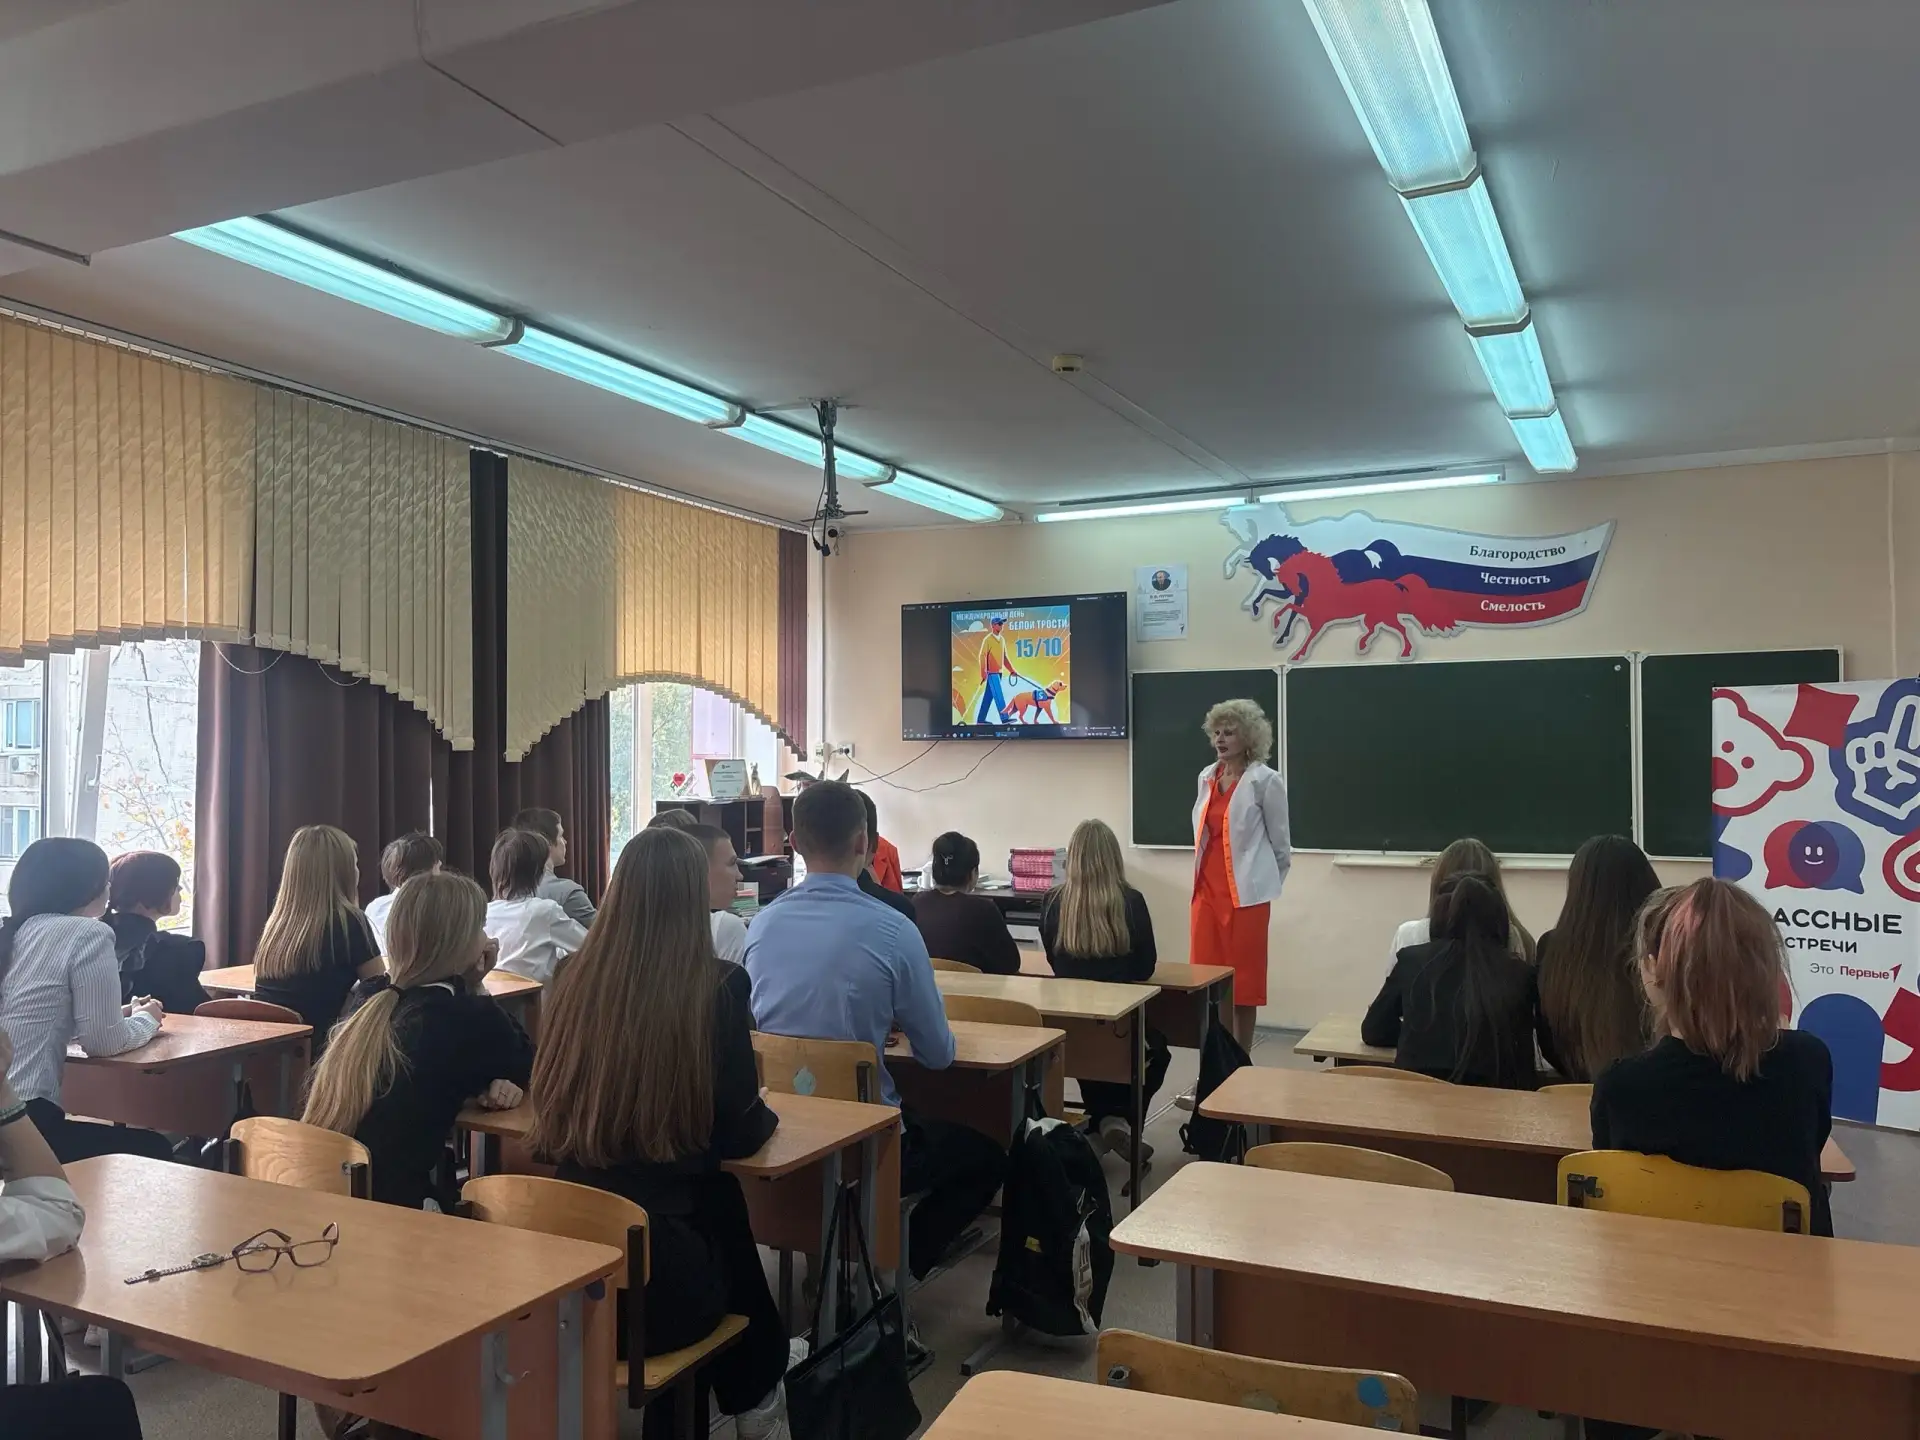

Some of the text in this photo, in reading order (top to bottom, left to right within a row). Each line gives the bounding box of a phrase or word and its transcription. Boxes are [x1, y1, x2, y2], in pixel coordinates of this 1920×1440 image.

[1469, 545, 1566, 561] Благородство
[1480, 572, 1551, 585] Честность
[1480, 599, 1546, 612] Смелость
[1009, 610, 1025, 619] ДЕНЬ
[1036, 619, 1068, 630] ТРОСТИ
[1015, 637, 1062, 658] 15/10
[1774, 907, 1902, 934] АССНЫЕ
[1785, 937, 1857, 953] СТРЕЧИ
[1809, 963, 1890, 980] Это Первые
